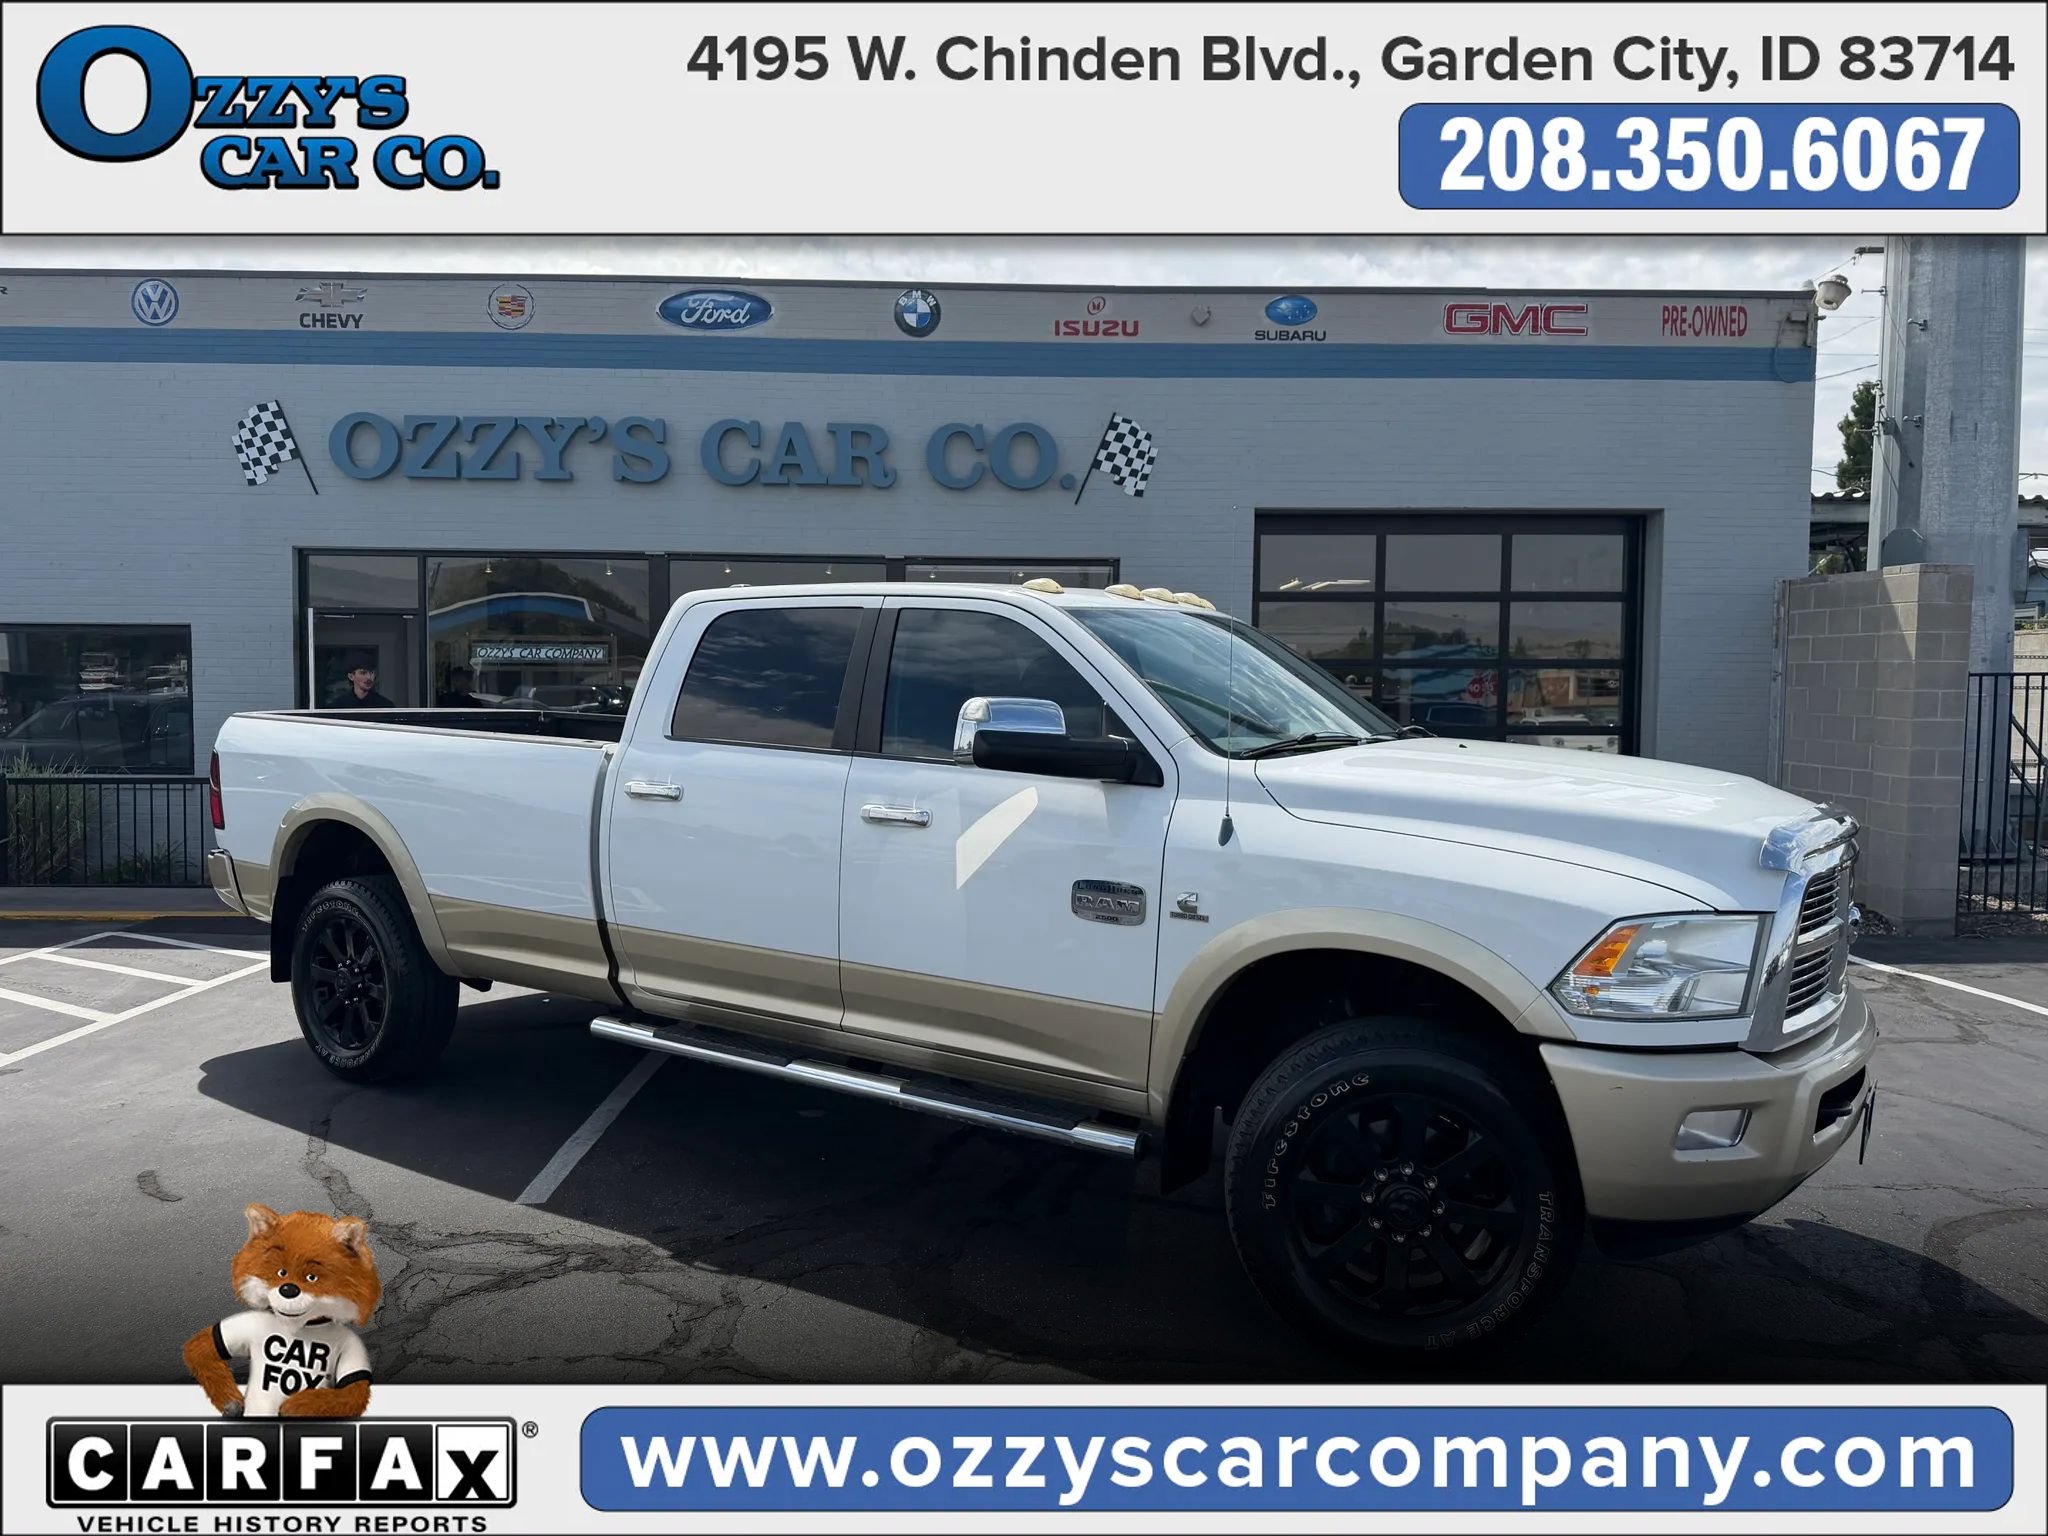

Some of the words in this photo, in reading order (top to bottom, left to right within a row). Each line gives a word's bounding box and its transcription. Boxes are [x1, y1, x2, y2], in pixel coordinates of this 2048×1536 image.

[300, 313, 363, 329] CHEVY
[680, 295, 752, 325] Ford
[1444, 302, 1588, 337] GMC
[1662, 305, 1748, 337] PRE-OWNED
[1055, 320, 1139, 337] ISUZU
[1254, 330, 1327, 341] SUBARU
[329, 411, 672, 483] OZZY'S
[701, 418, 897, 488] CAR
[925, 422, 1077, 491] CO.
[478, 647, 514, 658] OZZY'S
[520, 647, 541, 659] CAR
[544, 647, 603, 660] COMPANY
[1076, 894, 1140, 912] RAM
[1465, 1189, 1558, 1340] TRANSFORCE
[1424, 1329, 1458, 1351] AT
